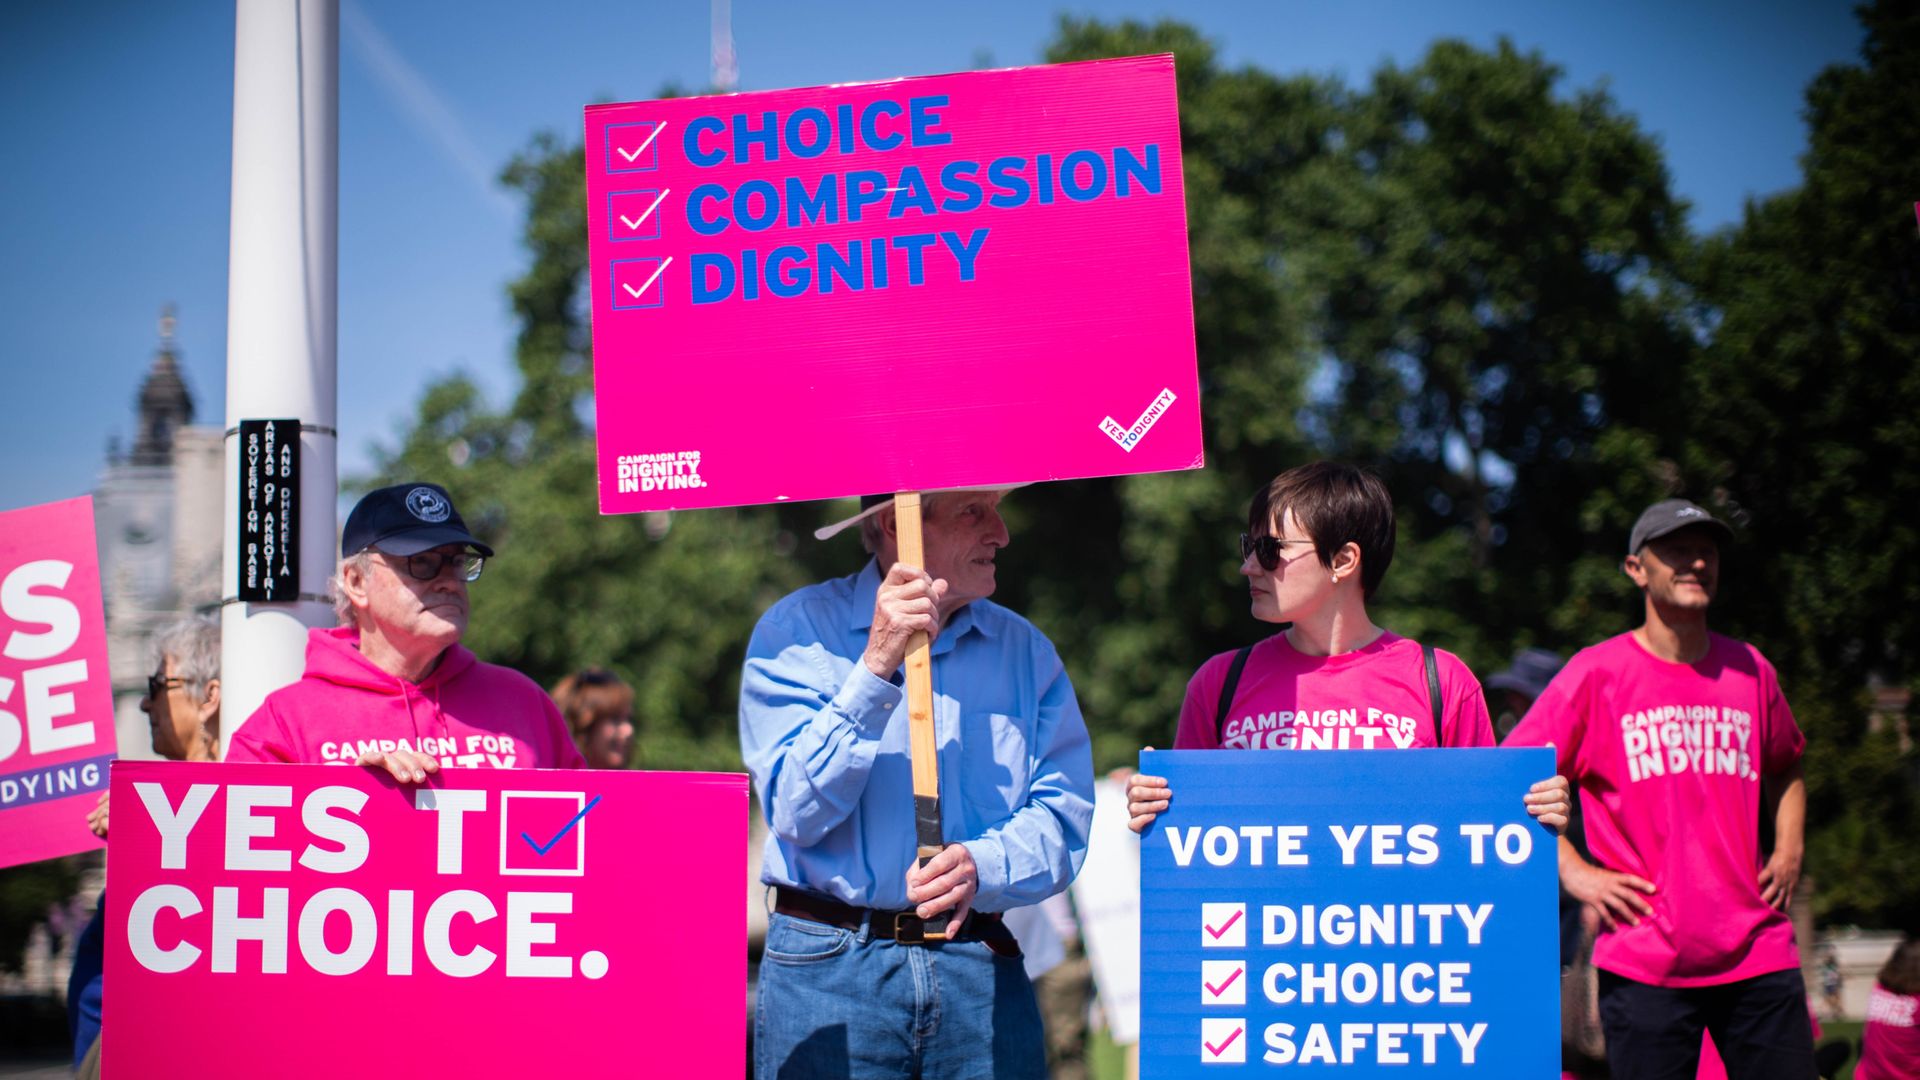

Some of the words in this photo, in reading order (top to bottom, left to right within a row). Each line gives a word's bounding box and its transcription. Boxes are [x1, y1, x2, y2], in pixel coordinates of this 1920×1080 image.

[682, 94, 953, 168] CHOICE
[684, 143, 1163, 237] COMPASSION
[688, 227, 992, 306] DIGNITY
[264, 420, 275, 476] AREAS
[1104, 420, 1126, 441] YES
[280, 443, 291, 477] AND
[617, 453, 675, 464] CAMPAIGN
[677, 450, 701, 460] FOR
[617, 459, 701, 479] DIGNITY
[247, 433, 258, 533] SOVEREIGN
[263, 483, 275, 506] OF
[618, 478, 639, 493] IN
[641, 474, 707, 491] DYING.
[279, 487, 291, 577] DHEKELIA
[247, 543, 257, 589] BASE
[263, 512, 275, 600] AKROTIRI
[1225, 708, 1357, 738] CAMPAIGN
[1367, 707, 1418, 736] FOR
[1621, 704, 1718, 731] CAMPAIGN
[1722, 706, 1752, 725] FOR
[321, 737, 457, 760] CAMPAIGN
[466, 735, 516, 755] FOR
[1622, 721, 1751, 758] DIGNITY
[1, 763, 100, 802] DYING
[1628, 753, 1665, 783] IN
[1668, 747, 1757, 782] DYING.
[133, 782, 370, 874] YES
[1165, 826, 1309, 867] VOTE
[1328, 824, 1440, 866] YES
[1460, 823, 1533, 865] TO
[127, 884, 609, 980] CHOICE.
[1261, 903, 1494, 946] DIGNITY
[1261, 962, 1472, 1004] CHOICE
[1261, 1022, 1488, 1065] SAFETY
